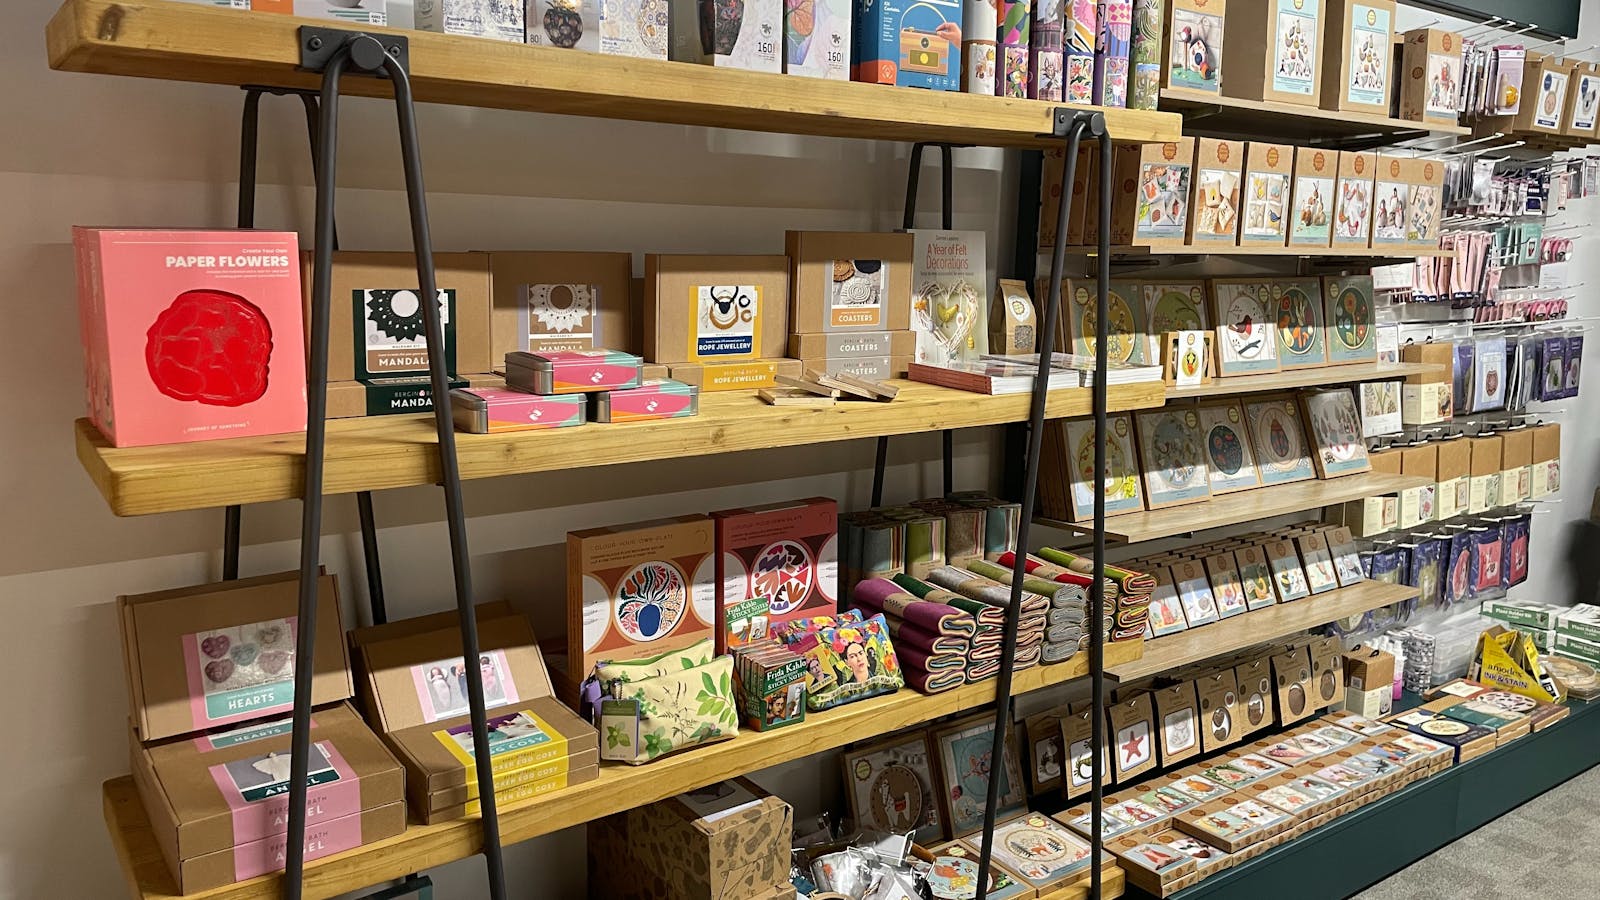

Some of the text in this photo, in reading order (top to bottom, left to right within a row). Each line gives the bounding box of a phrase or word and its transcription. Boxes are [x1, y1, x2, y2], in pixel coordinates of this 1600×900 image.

[529, 34, 539, 43] 80
[758, 41, 773, 53] 160
[827, 51, 842, 63] 160
[932, 243, 947, 255] Year
[955, 243, 968, 255] Felt
[165, 255, 289, 268] PAPER FLOWERS
[926, 255, 969, 270] Decorations
[838, 314, 873, 322] COASTERS
[698, 342, 751, 351] ROPE JEWELLERY
[839, 343, 878, 352] COASTERS
[732, 375, 767, 383] JEWELLERY
[391, 397, 433, 408] MANDA
[766, 668, 784, 681] Frida
[785, 660, 806, 674] Kahlo
[767, 678, 788, 691] STICKY
[228, 692, 275, 710] HEARTS
[234, 729, 281, 742] HEARTS
[508, 737, 543, 749] COSY
[536, 750, 557, 760] COSY
[537, 766, 559, 777] COSY
[535, 782, 557, 792] COSY
